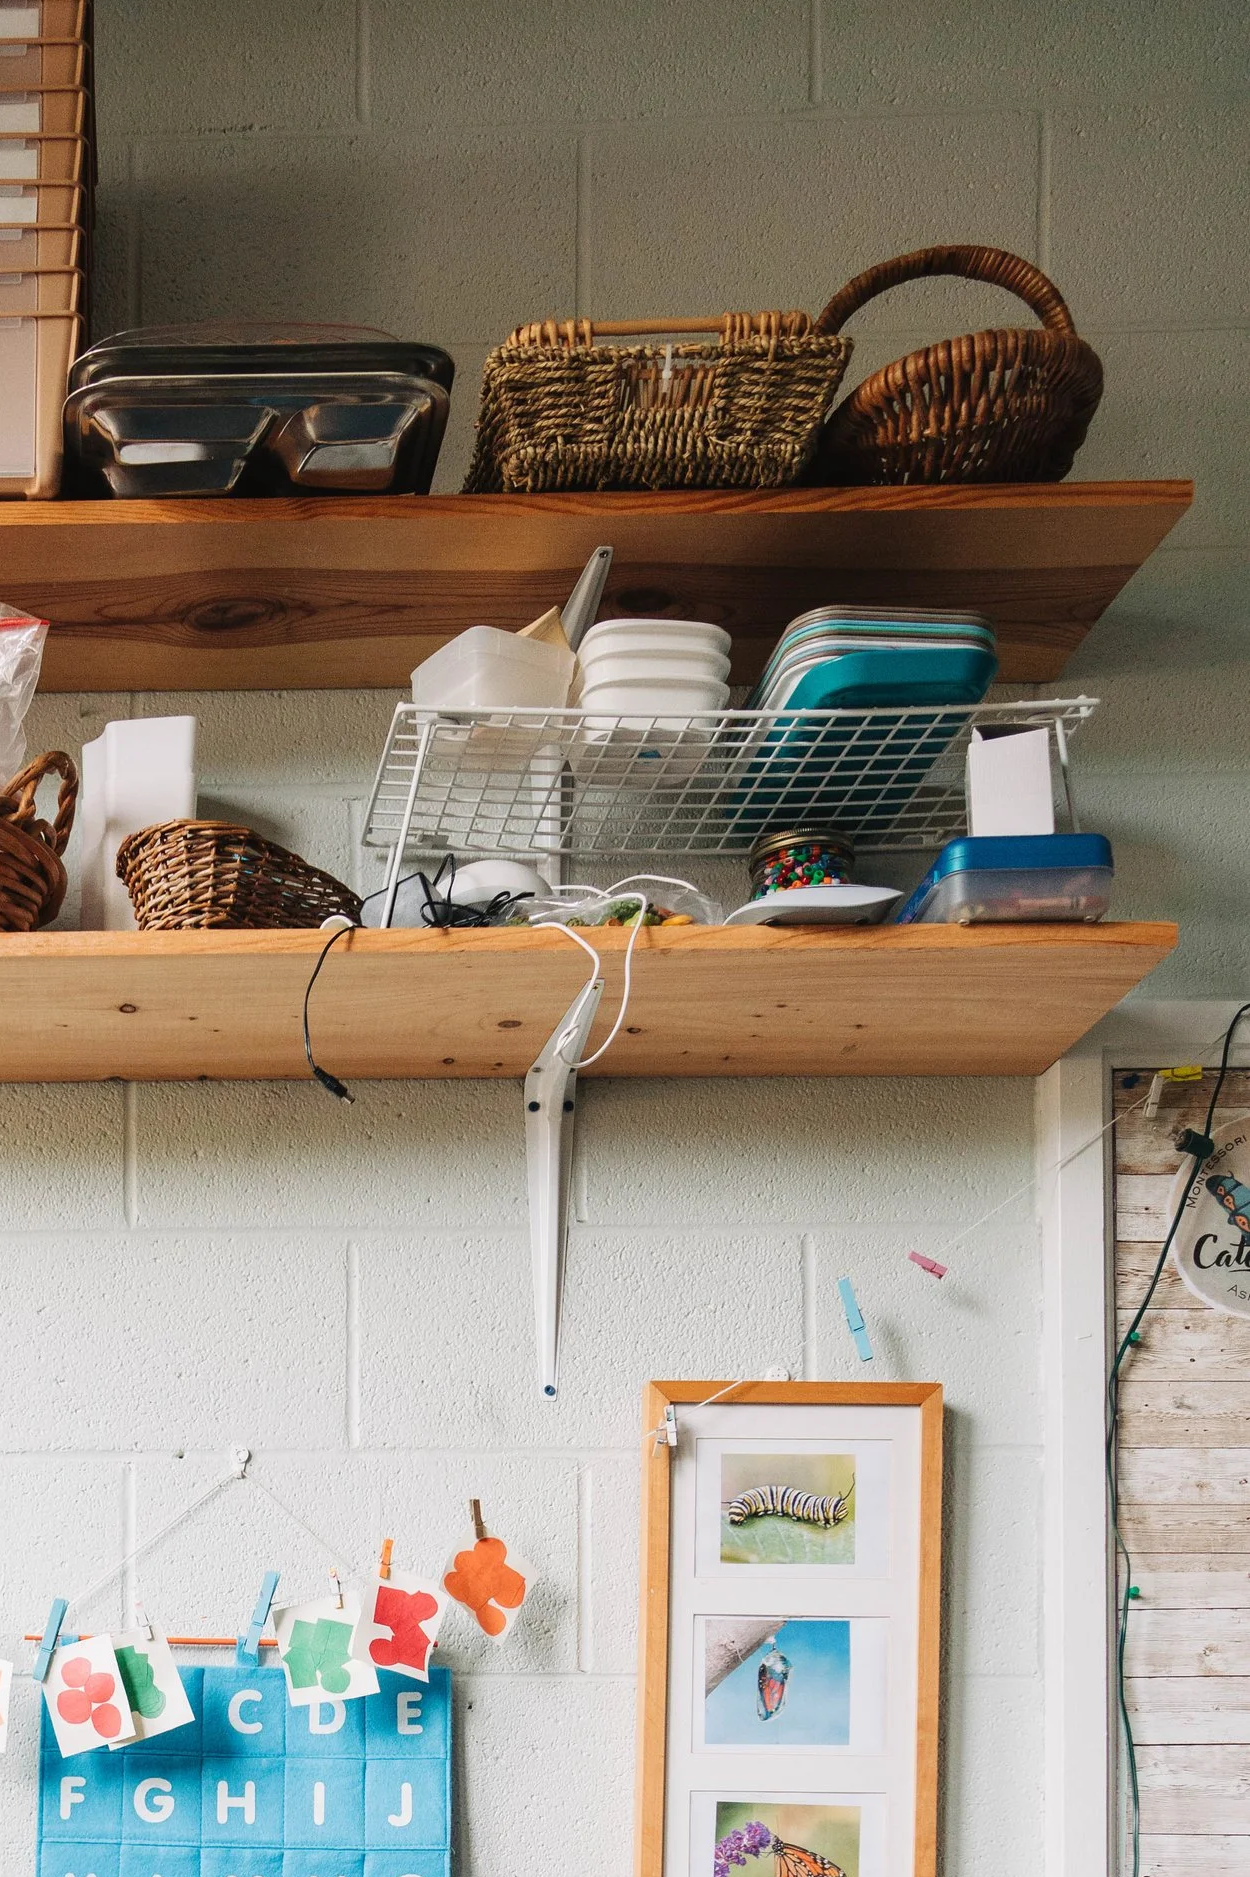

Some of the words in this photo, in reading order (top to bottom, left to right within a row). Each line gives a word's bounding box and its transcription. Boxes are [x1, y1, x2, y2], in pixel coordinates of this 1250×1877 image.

[1186, 1134, 1247, 1209] MONTESSORI
[1226, 1284, 1250, 1302] AS
[227, 1689, 263, 1735] C
[309, 1699, 347, 1735] D
[397, 1691, 424, 1735] E
[59, 1776, 87, 1820] F
[133, 1778, 175, 1823] G
[216, 1780, 256, 1825] H
[313, 1781, 325, 1826] I
[388, 1782, 413, 1827] J
